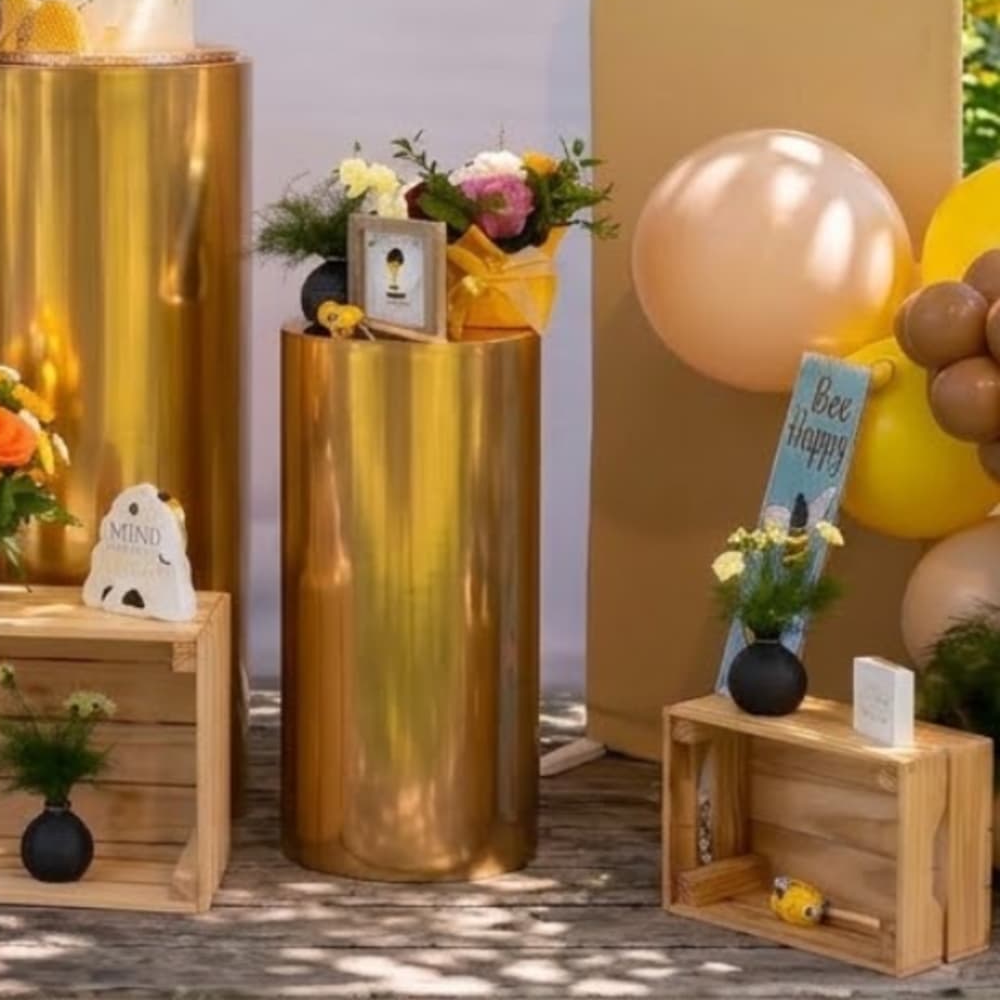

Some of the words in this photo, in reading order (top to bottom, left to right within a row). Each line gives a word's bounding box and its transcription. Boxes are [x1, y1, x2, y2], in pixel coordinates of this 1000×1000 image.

[811, 375, 853, 423] Bee
[787, 407, 849, 479] Happy
[108, 522, 162, 546] MIND
